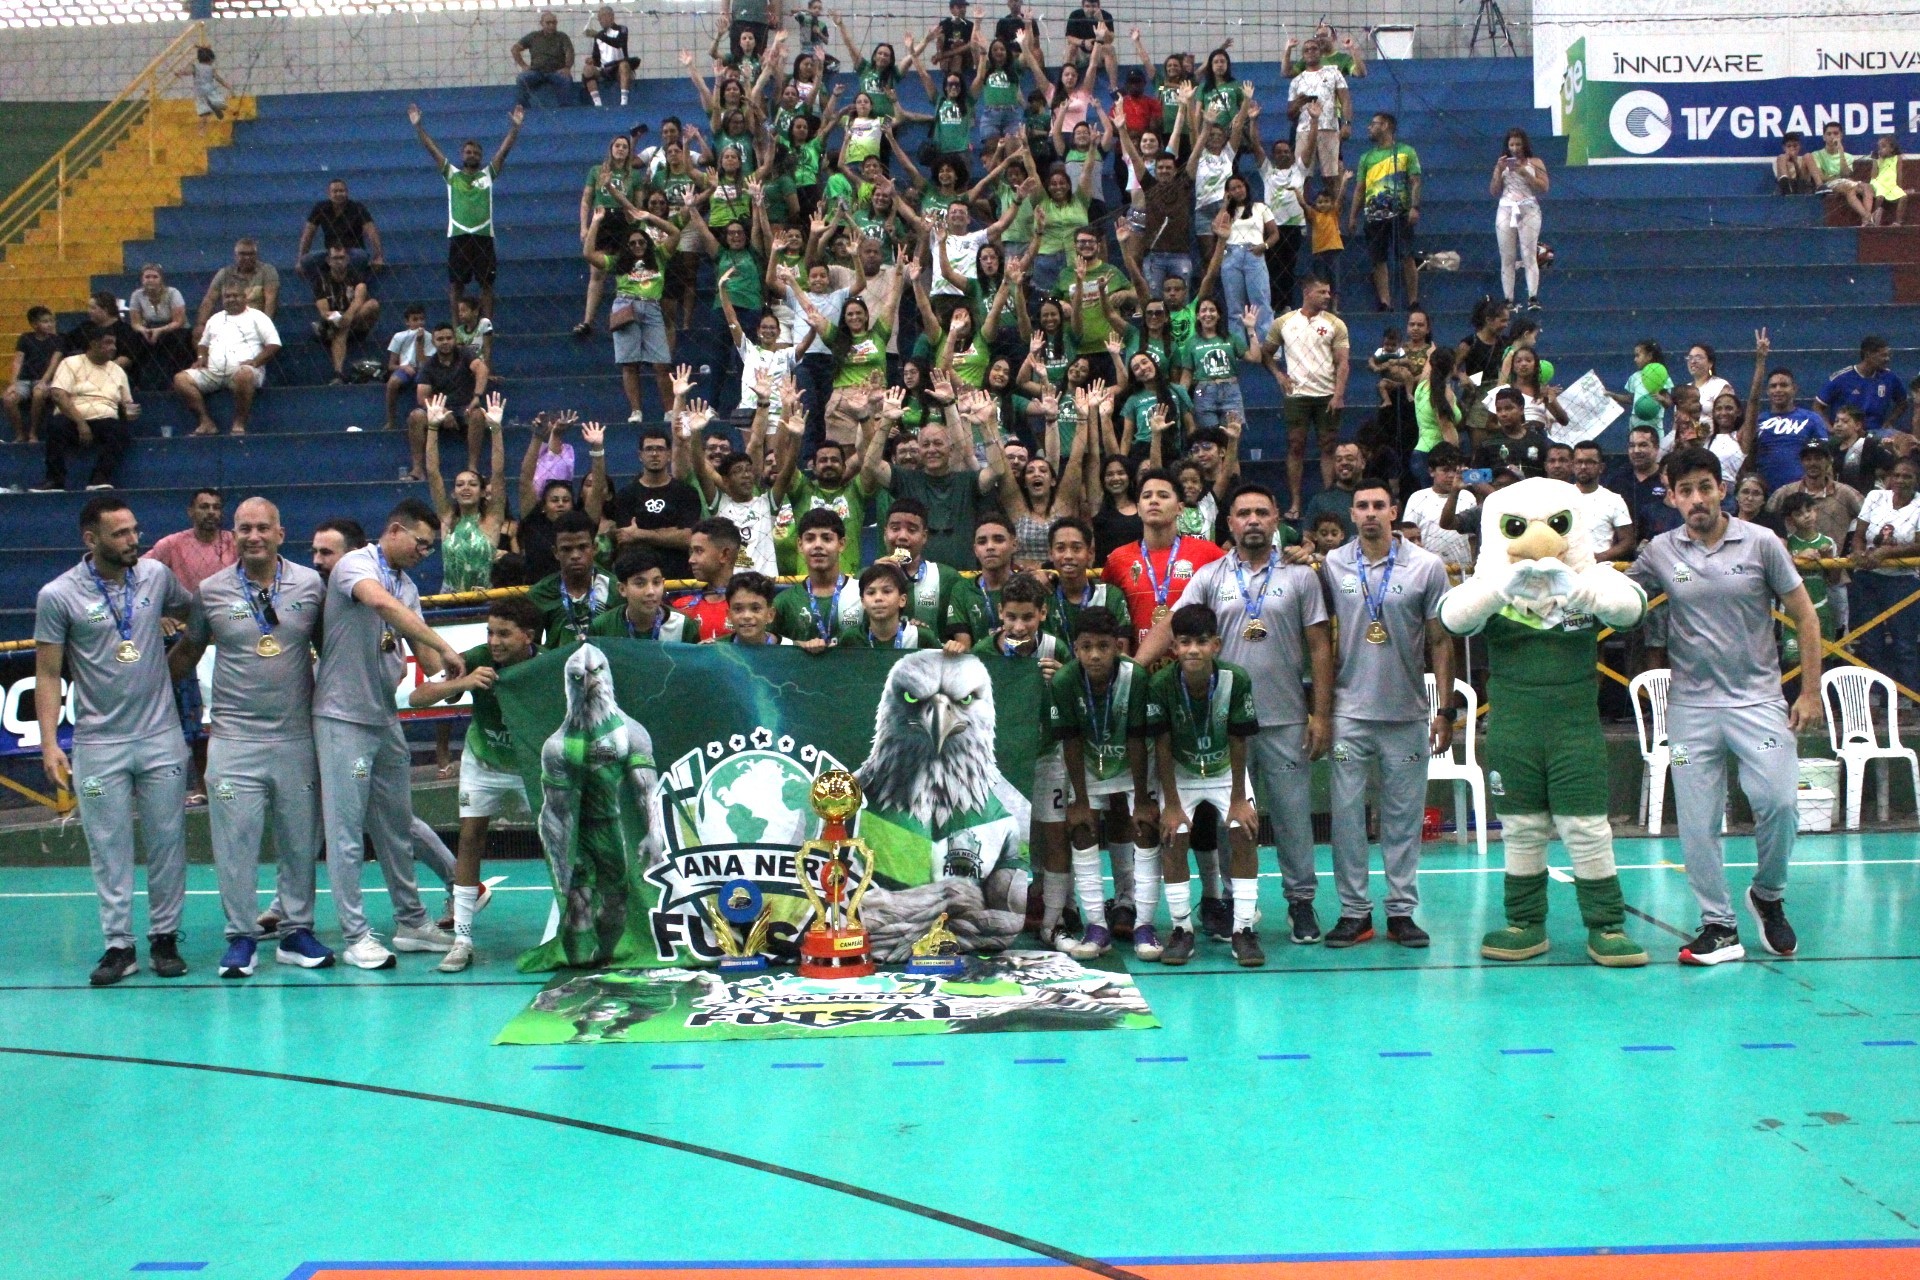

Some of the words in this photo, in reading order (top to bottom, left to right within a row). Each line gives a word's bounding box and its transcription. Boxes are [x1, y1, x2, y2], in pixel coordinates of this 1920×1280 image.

[1053, 788, 1064, 810] 2
[684, 854, 745, 878] ANA
[689, 1004, 972, 1027] FUTSAL
